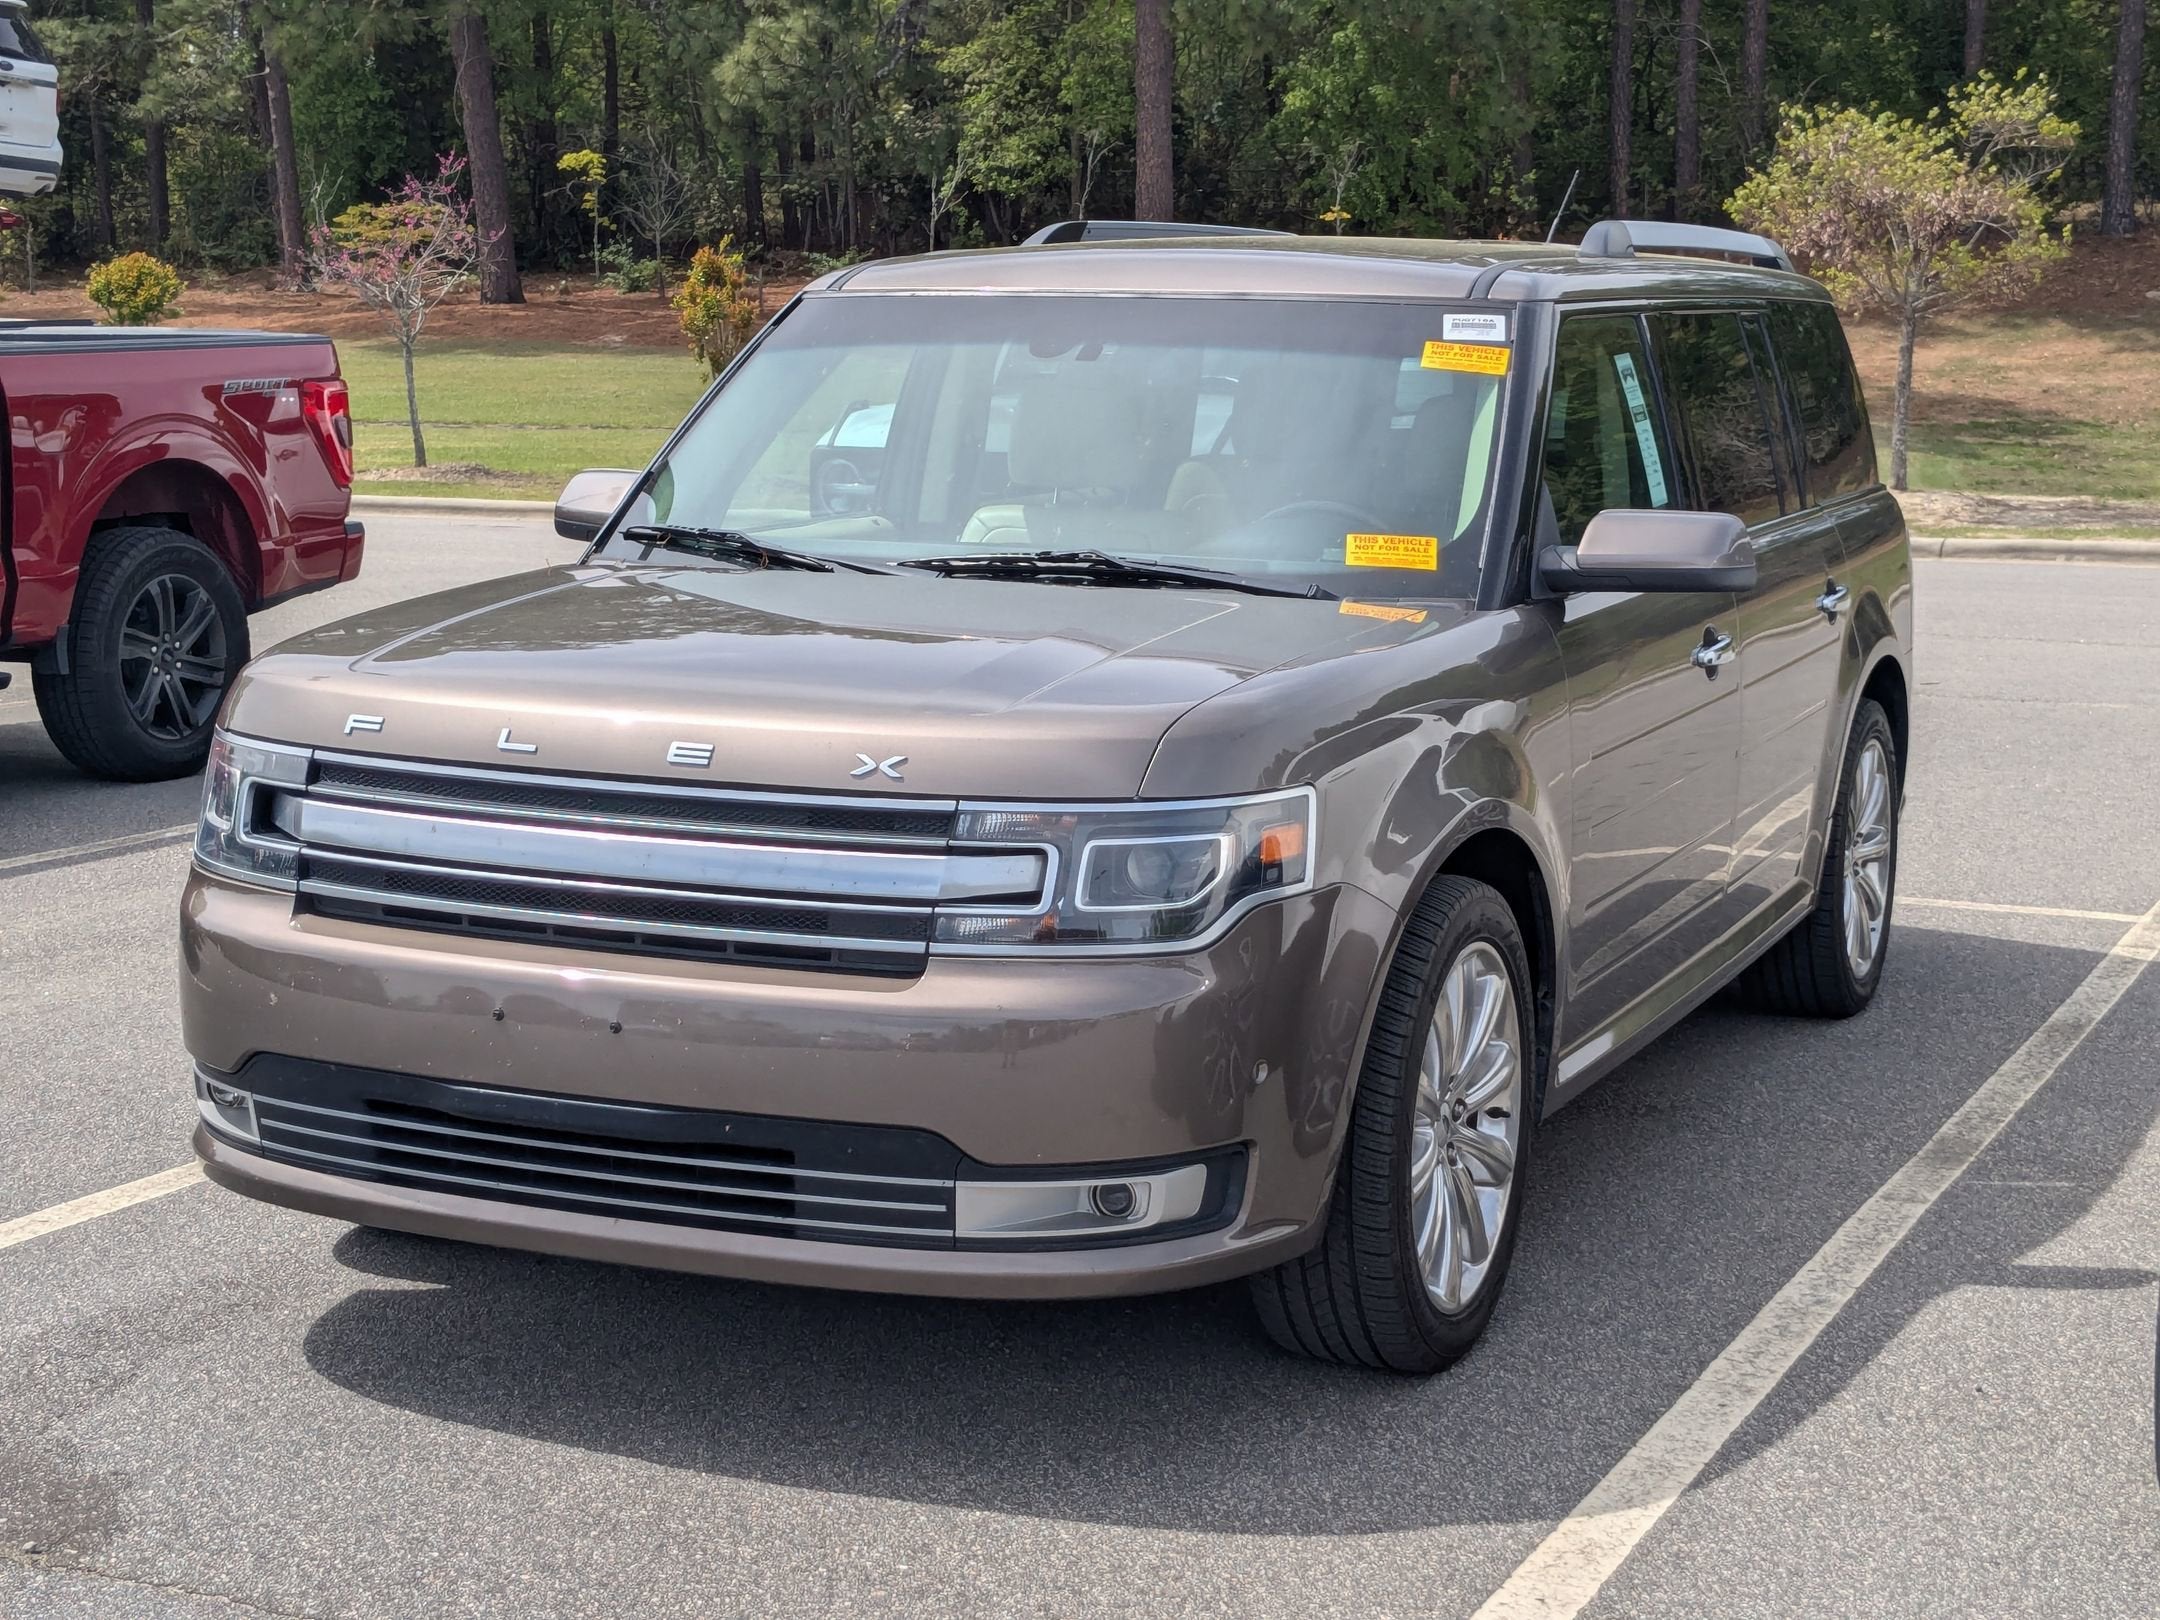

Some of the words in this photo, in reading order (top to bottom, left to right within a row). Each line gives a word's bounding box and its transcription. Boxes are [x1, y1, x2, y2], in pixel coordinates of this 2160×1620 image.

[1430, 343, 1454, 351] THIS
[1458, 345, 1506, 356] VEHICLE
[224, 378, 288, 394] SPORT
[1352, 536, 1379, 544] THIS
[1382, 537, 1432, 546] VEHICLE
[344, 713, 908, 780] FLEX
